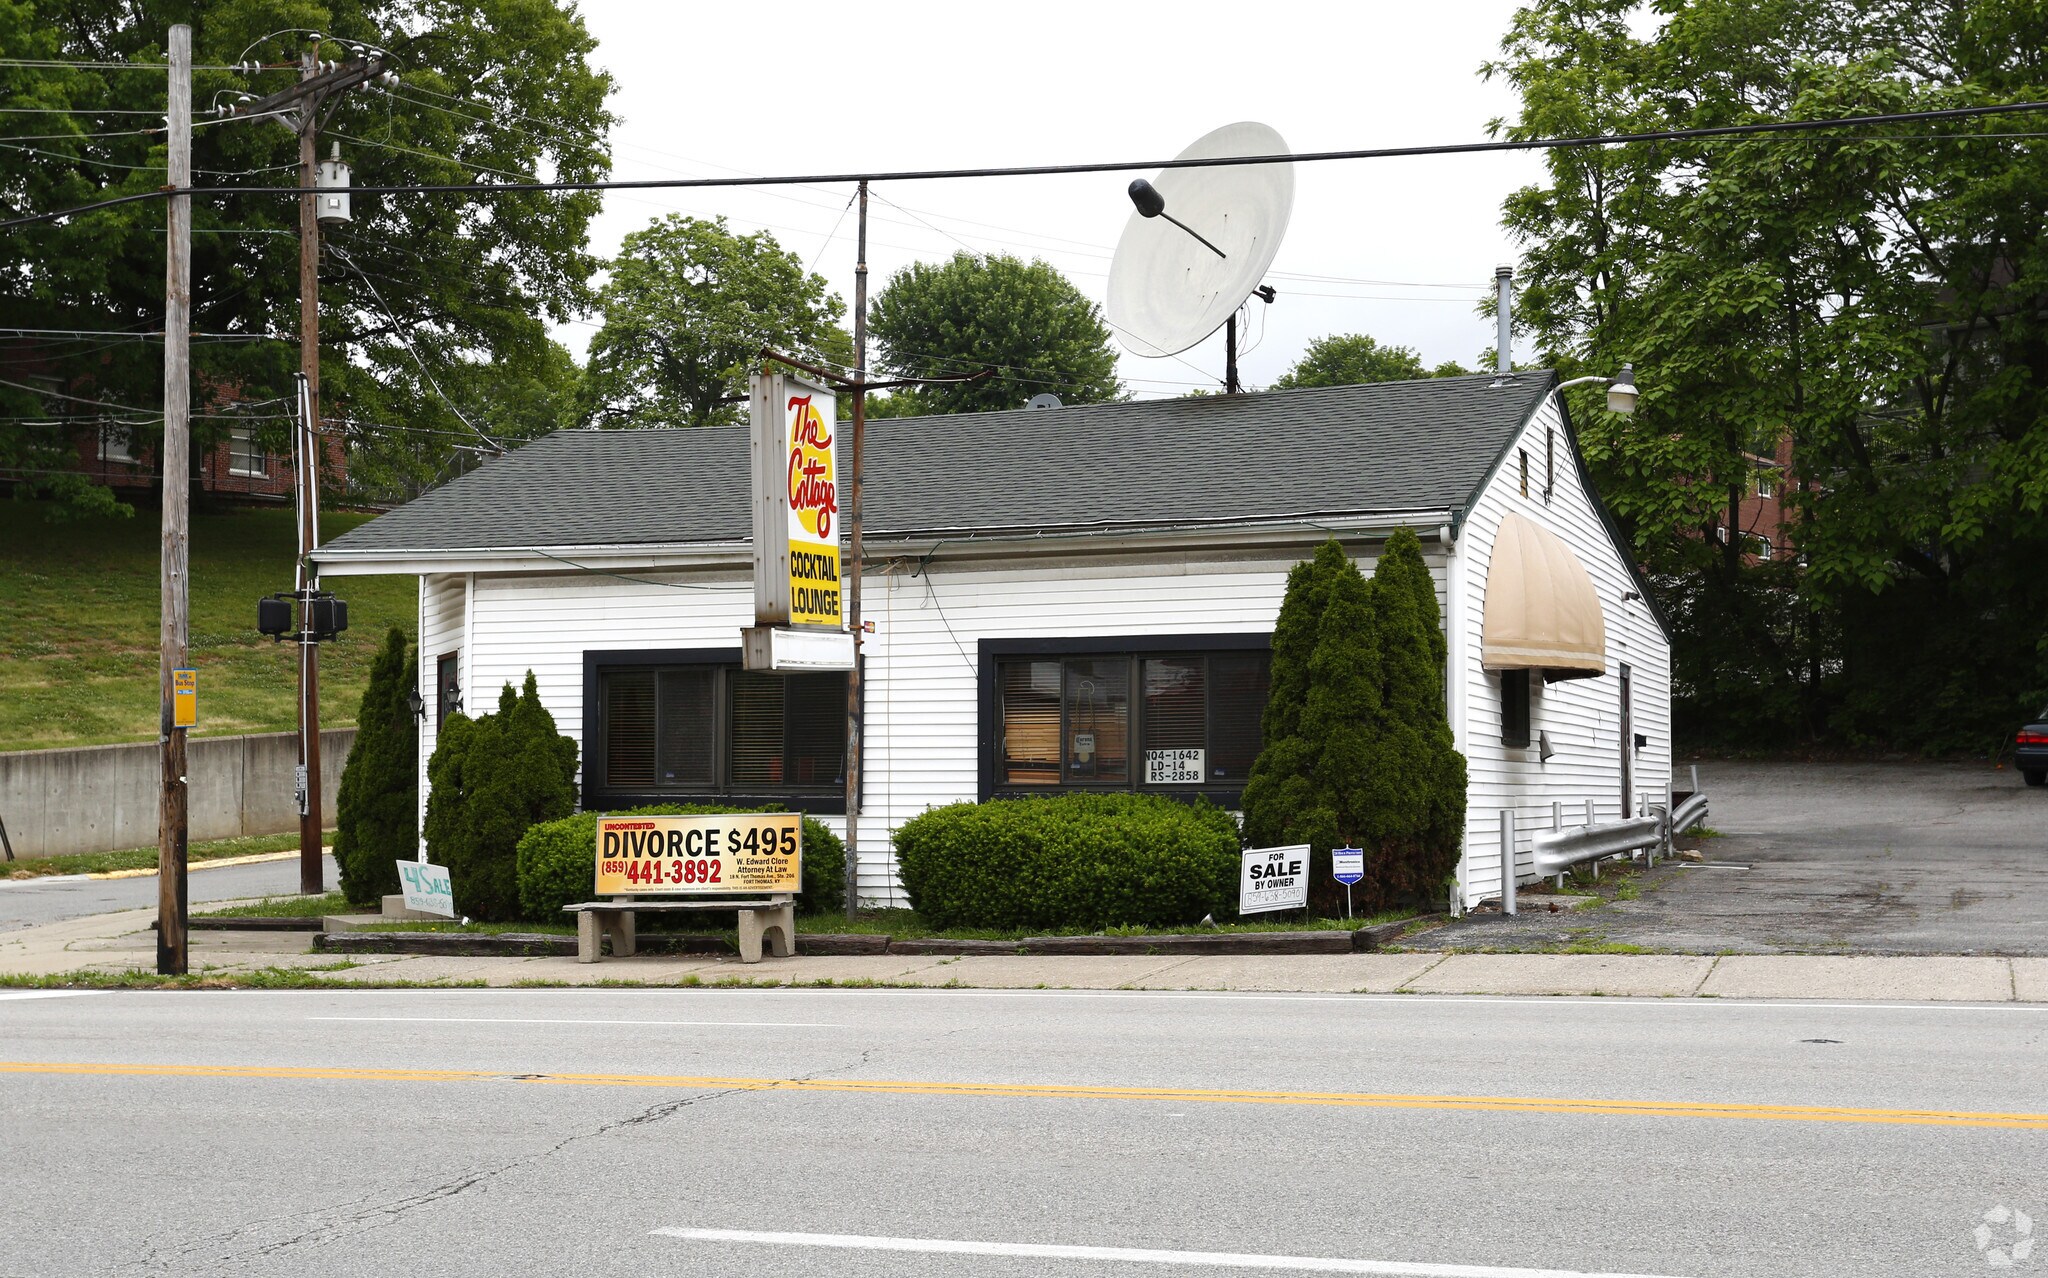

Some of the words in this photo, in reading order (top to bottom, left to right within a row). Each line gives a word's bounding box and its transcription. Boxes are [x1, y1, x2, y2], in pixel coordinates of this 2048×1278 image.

[788, 394, 832, 449] The
[788, 447, 837, 538] Cottage
[791, 550, 837, 582] COCKTAIL
[791, 587, 838, 616] LOUNGE
[1151, 761, 1185, 770] LD-14
[1151, 771, 1199, 781] RS-2858
[603, 829, 720, 858] DIVORCE
[746, 857, 770, 865] Edward
[1268, 853, 1284, 861] FOR
[737, 866, 765, 874] Attorney
[1249, 860, 1302, 880] SALE
[1255, 880, 1265, 890] BY
[1267, 877, 1294, 889] OWNER
